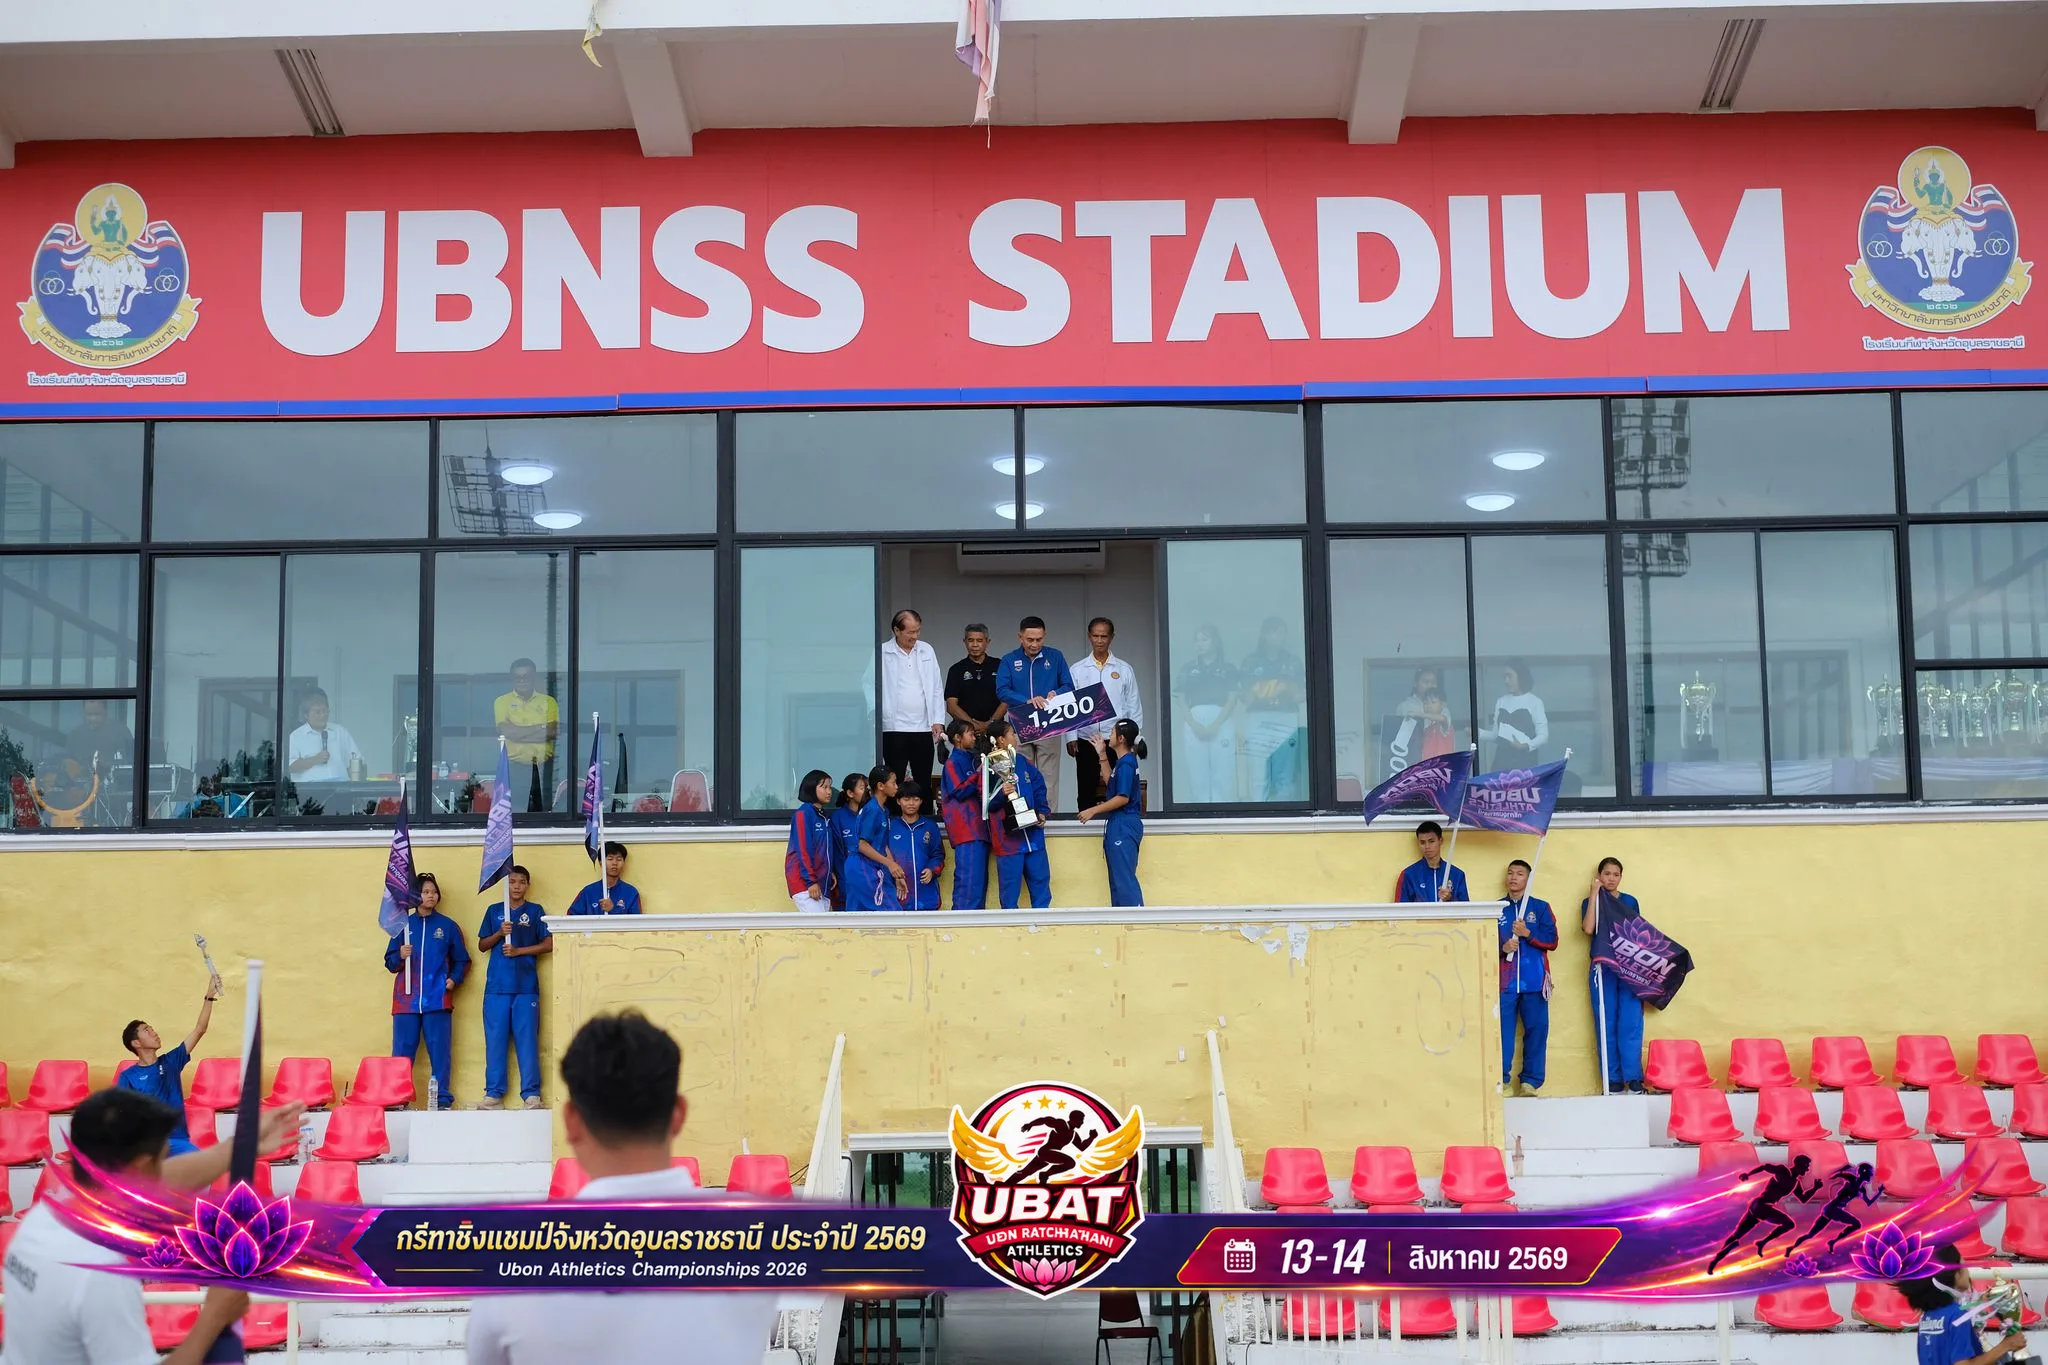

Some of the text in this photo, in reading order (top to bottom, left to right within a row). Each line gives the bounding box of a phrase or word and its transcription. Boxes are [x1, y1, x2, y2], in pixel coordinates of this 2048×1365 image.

[260, 187, 1791, 356] UBNSS STADIUM
[1028, 696, 1094, 728] 1,200
